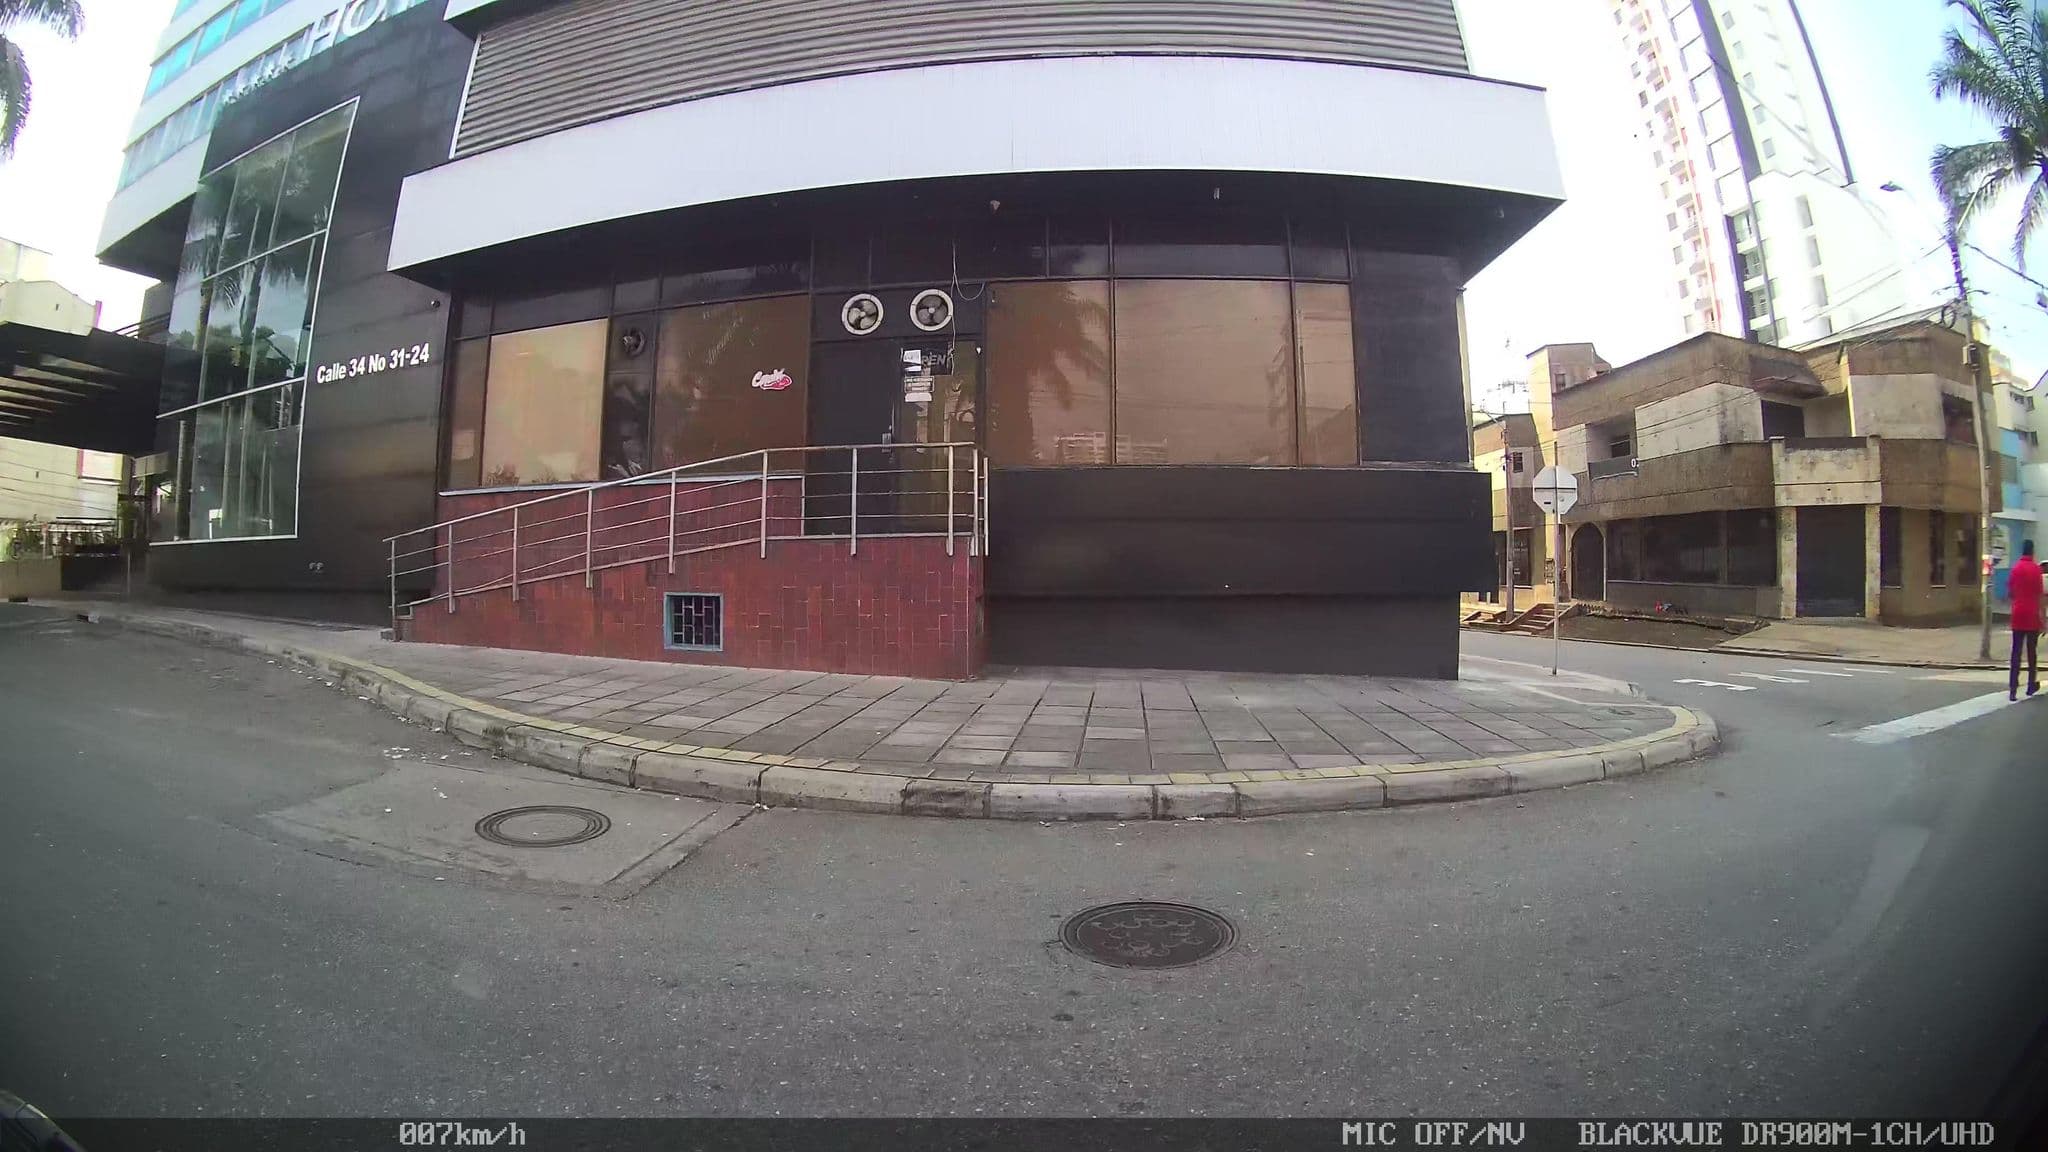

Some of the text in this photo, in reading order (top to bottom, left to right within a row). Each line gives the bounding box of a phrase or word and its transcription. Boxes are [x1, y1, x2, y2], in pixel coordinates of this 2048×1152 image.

[317, 342, 430, 384] Calle 34 No 31-24
[922, 354, 947, 367] PEN
